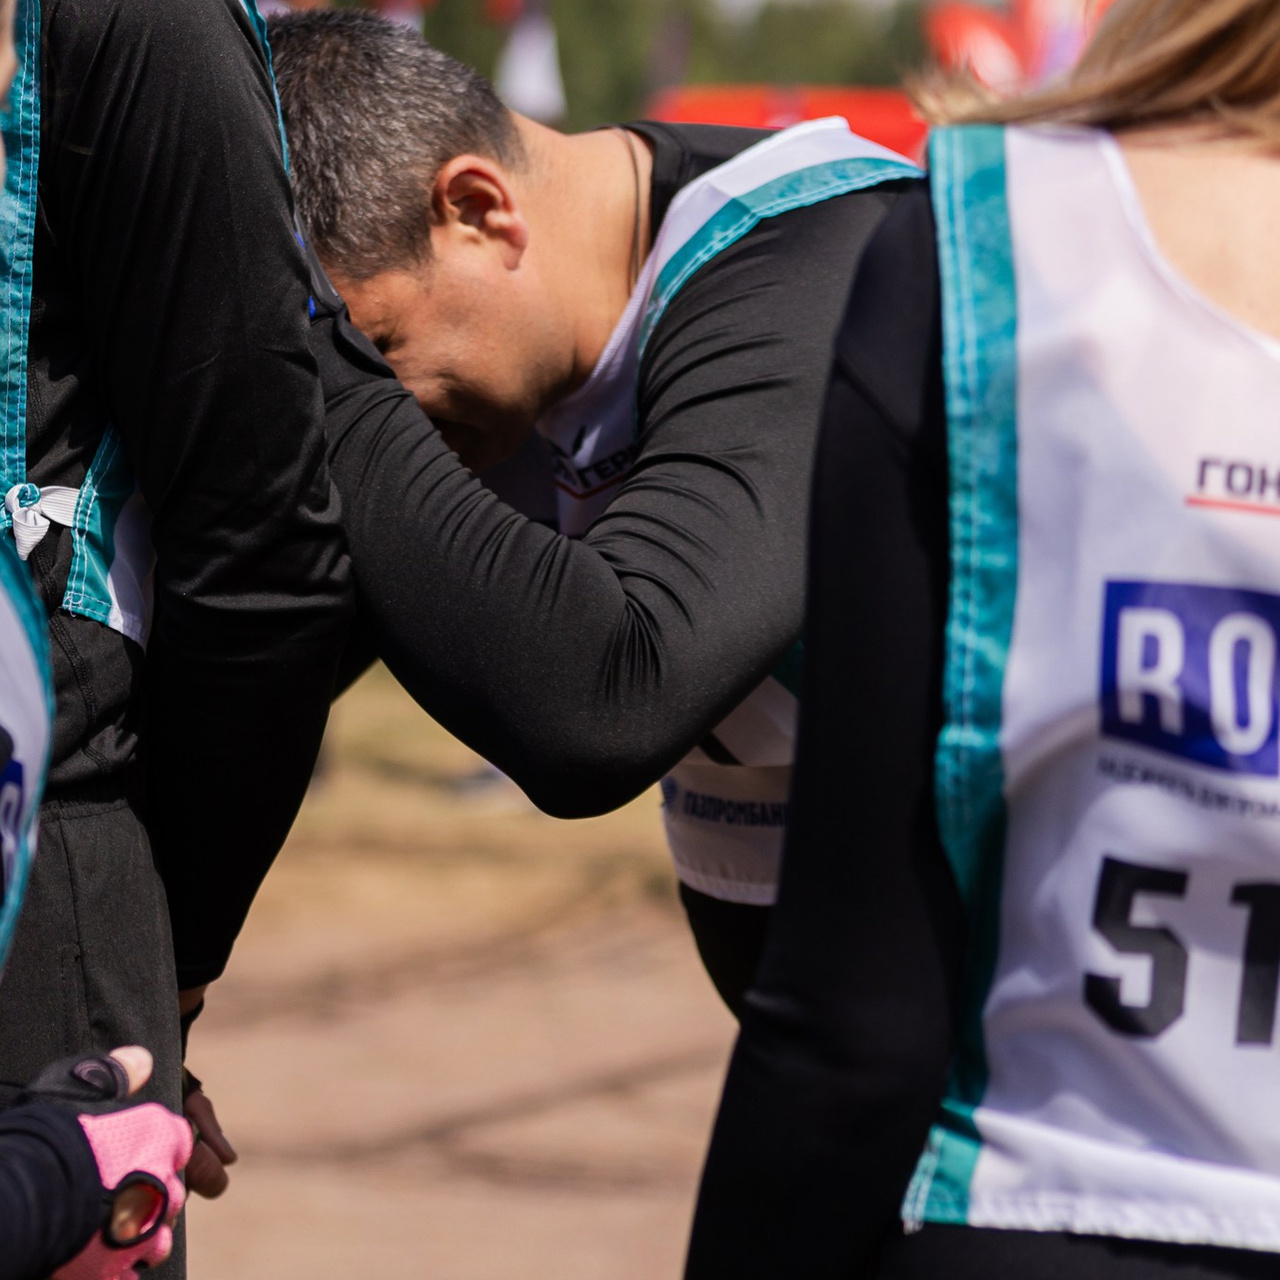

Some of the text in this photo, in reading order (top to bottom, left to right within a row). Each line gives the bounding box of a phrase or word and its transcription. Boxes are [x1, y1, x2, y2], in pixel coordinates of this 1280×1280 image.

[1198, 456, 1280, 500] ГОН
[683, 791, 788, 827] ГАЗПРОМБАН
[1083, 854, 1280, 1046] 51
